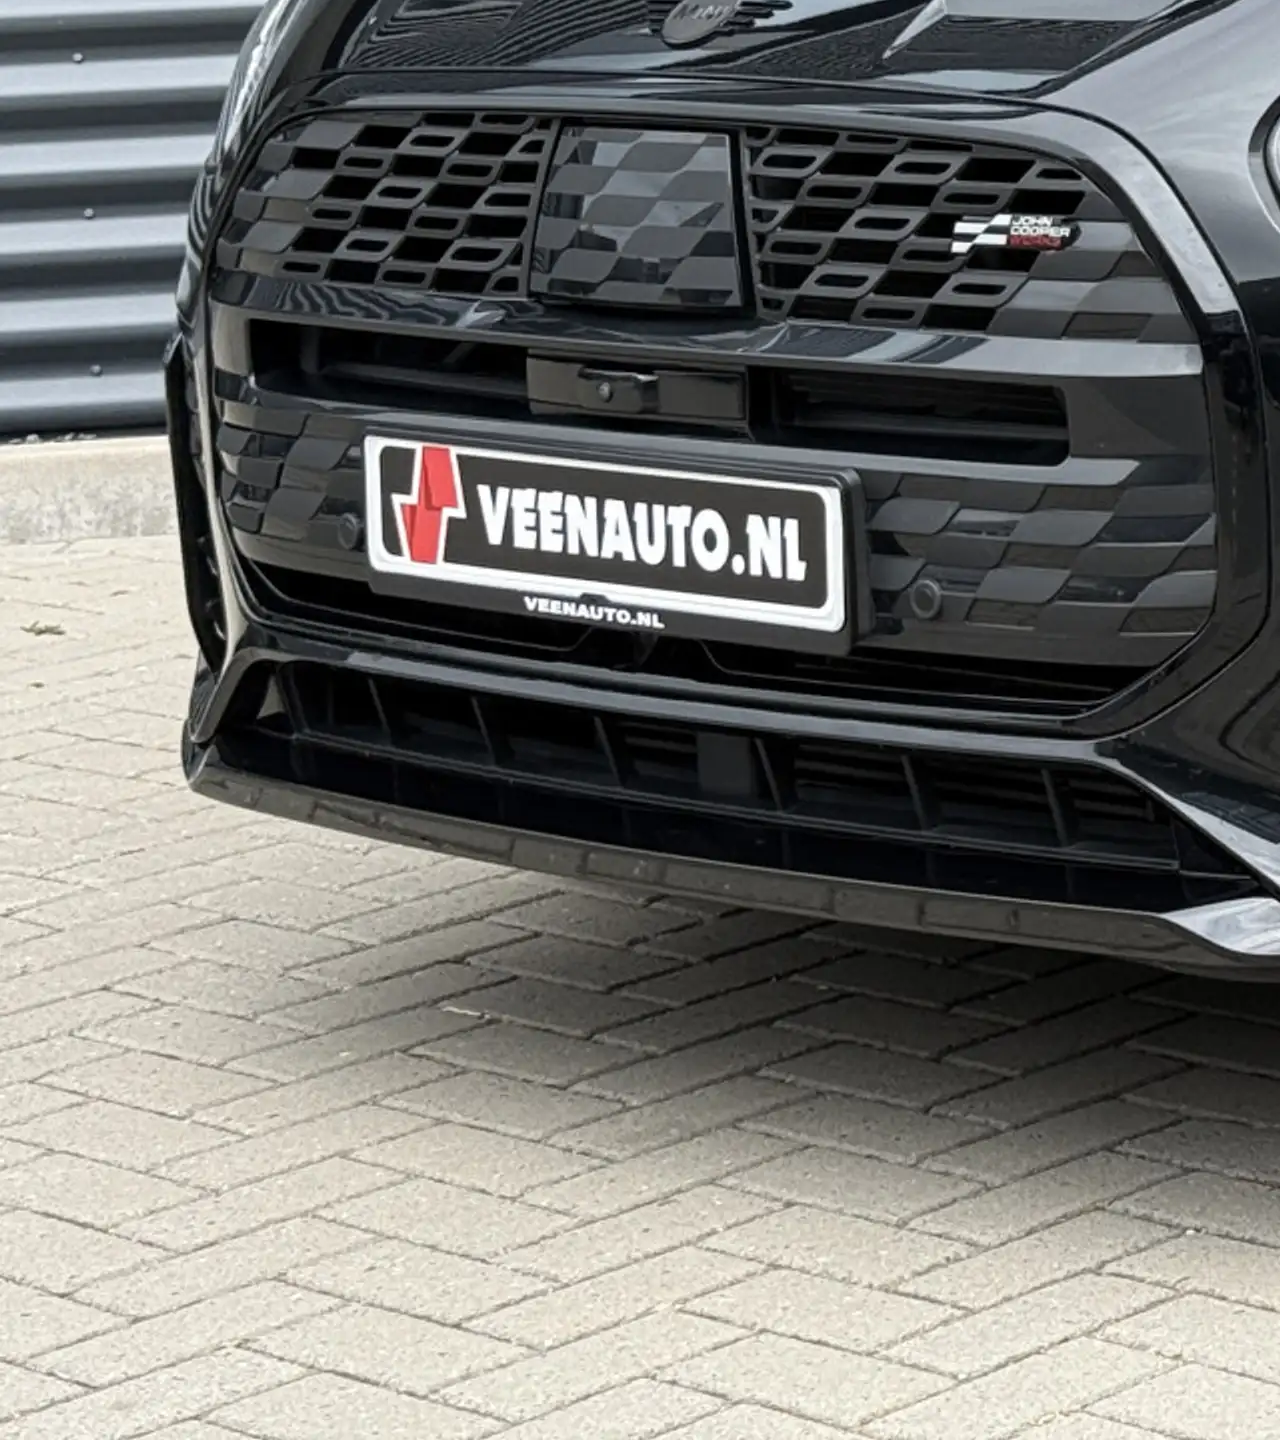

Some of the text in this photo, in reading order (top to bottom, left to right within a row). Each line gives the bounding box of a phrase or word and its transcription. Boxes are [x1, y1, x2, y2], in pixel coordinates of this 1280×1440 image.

[1010, 225, 1071, 237] COOPER
[476, 483, 807, 582] VEENAUTO.NL
[524, 595, 665, 630] VEENAUTO.NL
